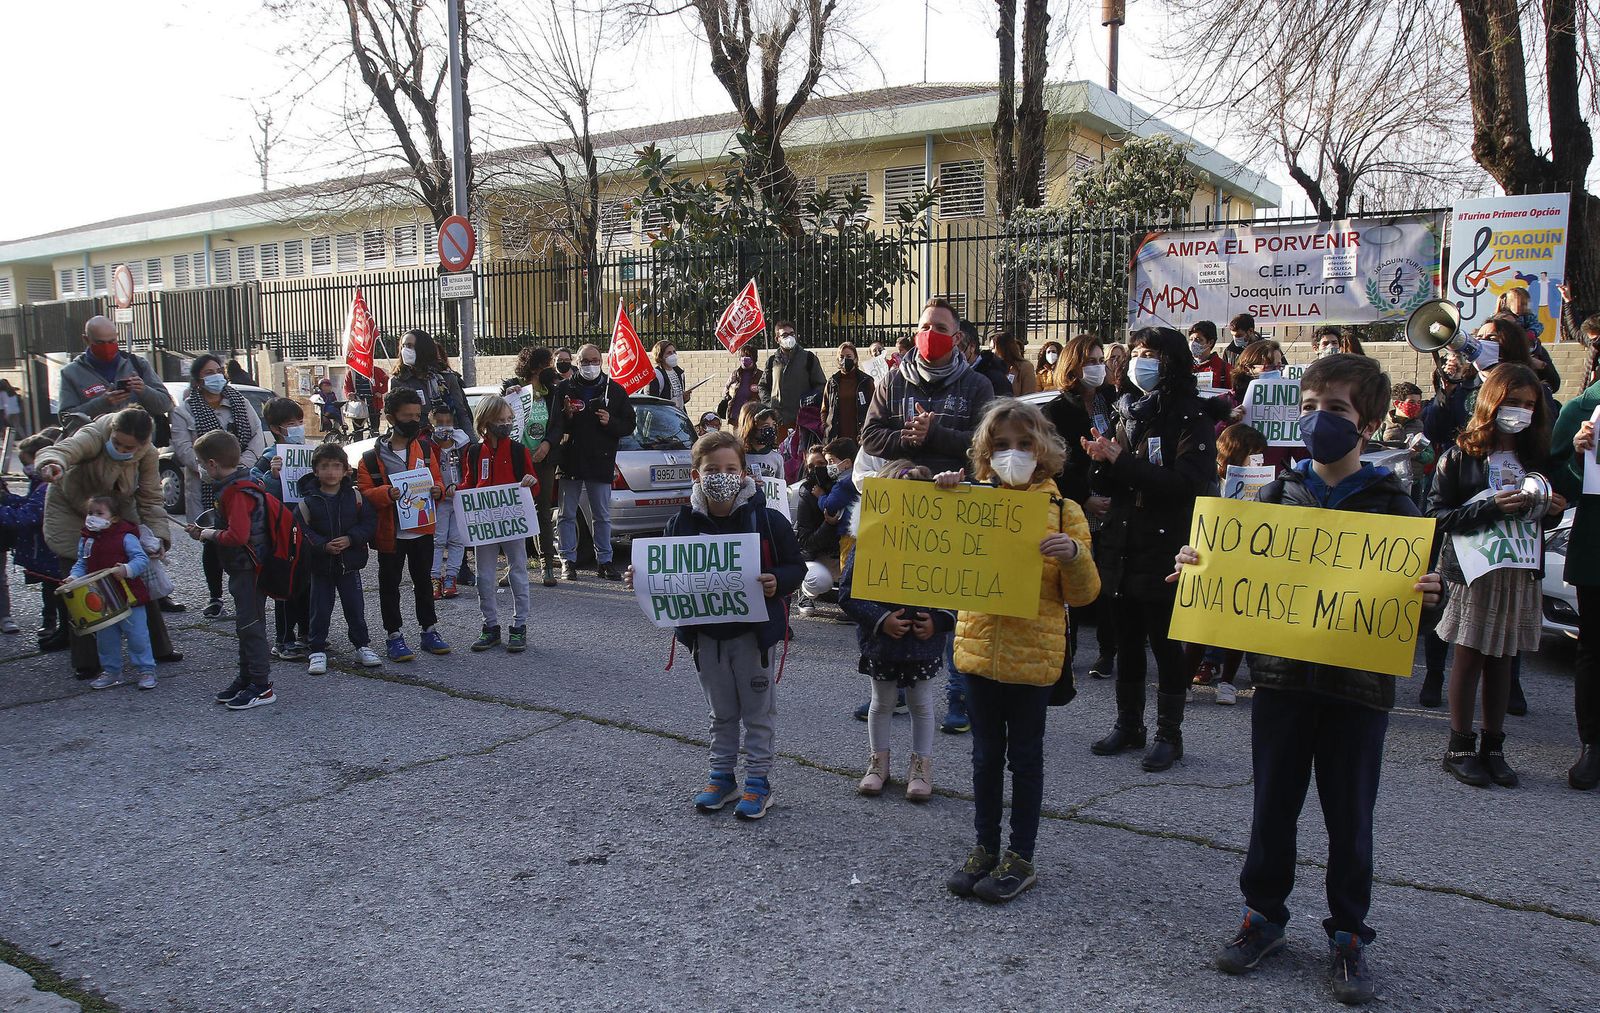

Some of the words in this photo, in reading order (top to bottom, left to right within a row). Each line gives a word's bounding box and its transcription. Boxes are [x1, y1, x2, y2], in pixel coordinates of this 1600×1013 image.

[1458, 211, 1490, 220] #Turina
[1492, 209, 1527, 218] Primera
[1529, 206, 1561, 218] Opción
[1166, 240, 1219, 257] AMPA
[1224, 239, 1249, 255] EL
[1254, 231, 1361, 253] PORVENIR
[1493, 230, 1562, 246] JOAQUÍN
[1496, 247, 1552, 260] TURINA
[1258, 264, 1311, 279] C.E.I.P.
[1230, 284, 1292, 300] Joaquín
[1295, 283, 1345, 297] Turina
[1248, 302, 1321, 319] SEVILLA
[1288, 366, 1304, 380] BA
[1252, 384, 1300, 406] BLIND
[656, 468, 675, 480] 9952
[461, 487, 523, 512] BLINDAJE
[864, 488, 891, 515] NO
[901, 492, 943, 521] NOS
[956, 499, 1024, 533] ROBÉIS
[467, 517, 529, 542] PÚBLICAS
[882, 521, 951, 554] NIÑOS
[962, 532, 987, 556] DE
[647, 541, 742, 574] BLINDAJE
[1194, 514, 1243, 553] NO
[1250, 522, 1425, 578] QUEREMOS
[867, 559, 890, 588] LA
[901, 563, 1004, 598] ESCUELA
[651, 591, 749, 621] PÚBLICAS
[1179, 572, 1224, 613] UNA
[1233, 577, 1308, 625] CLASE
[1312, 589, 1419, 643] MENOS
